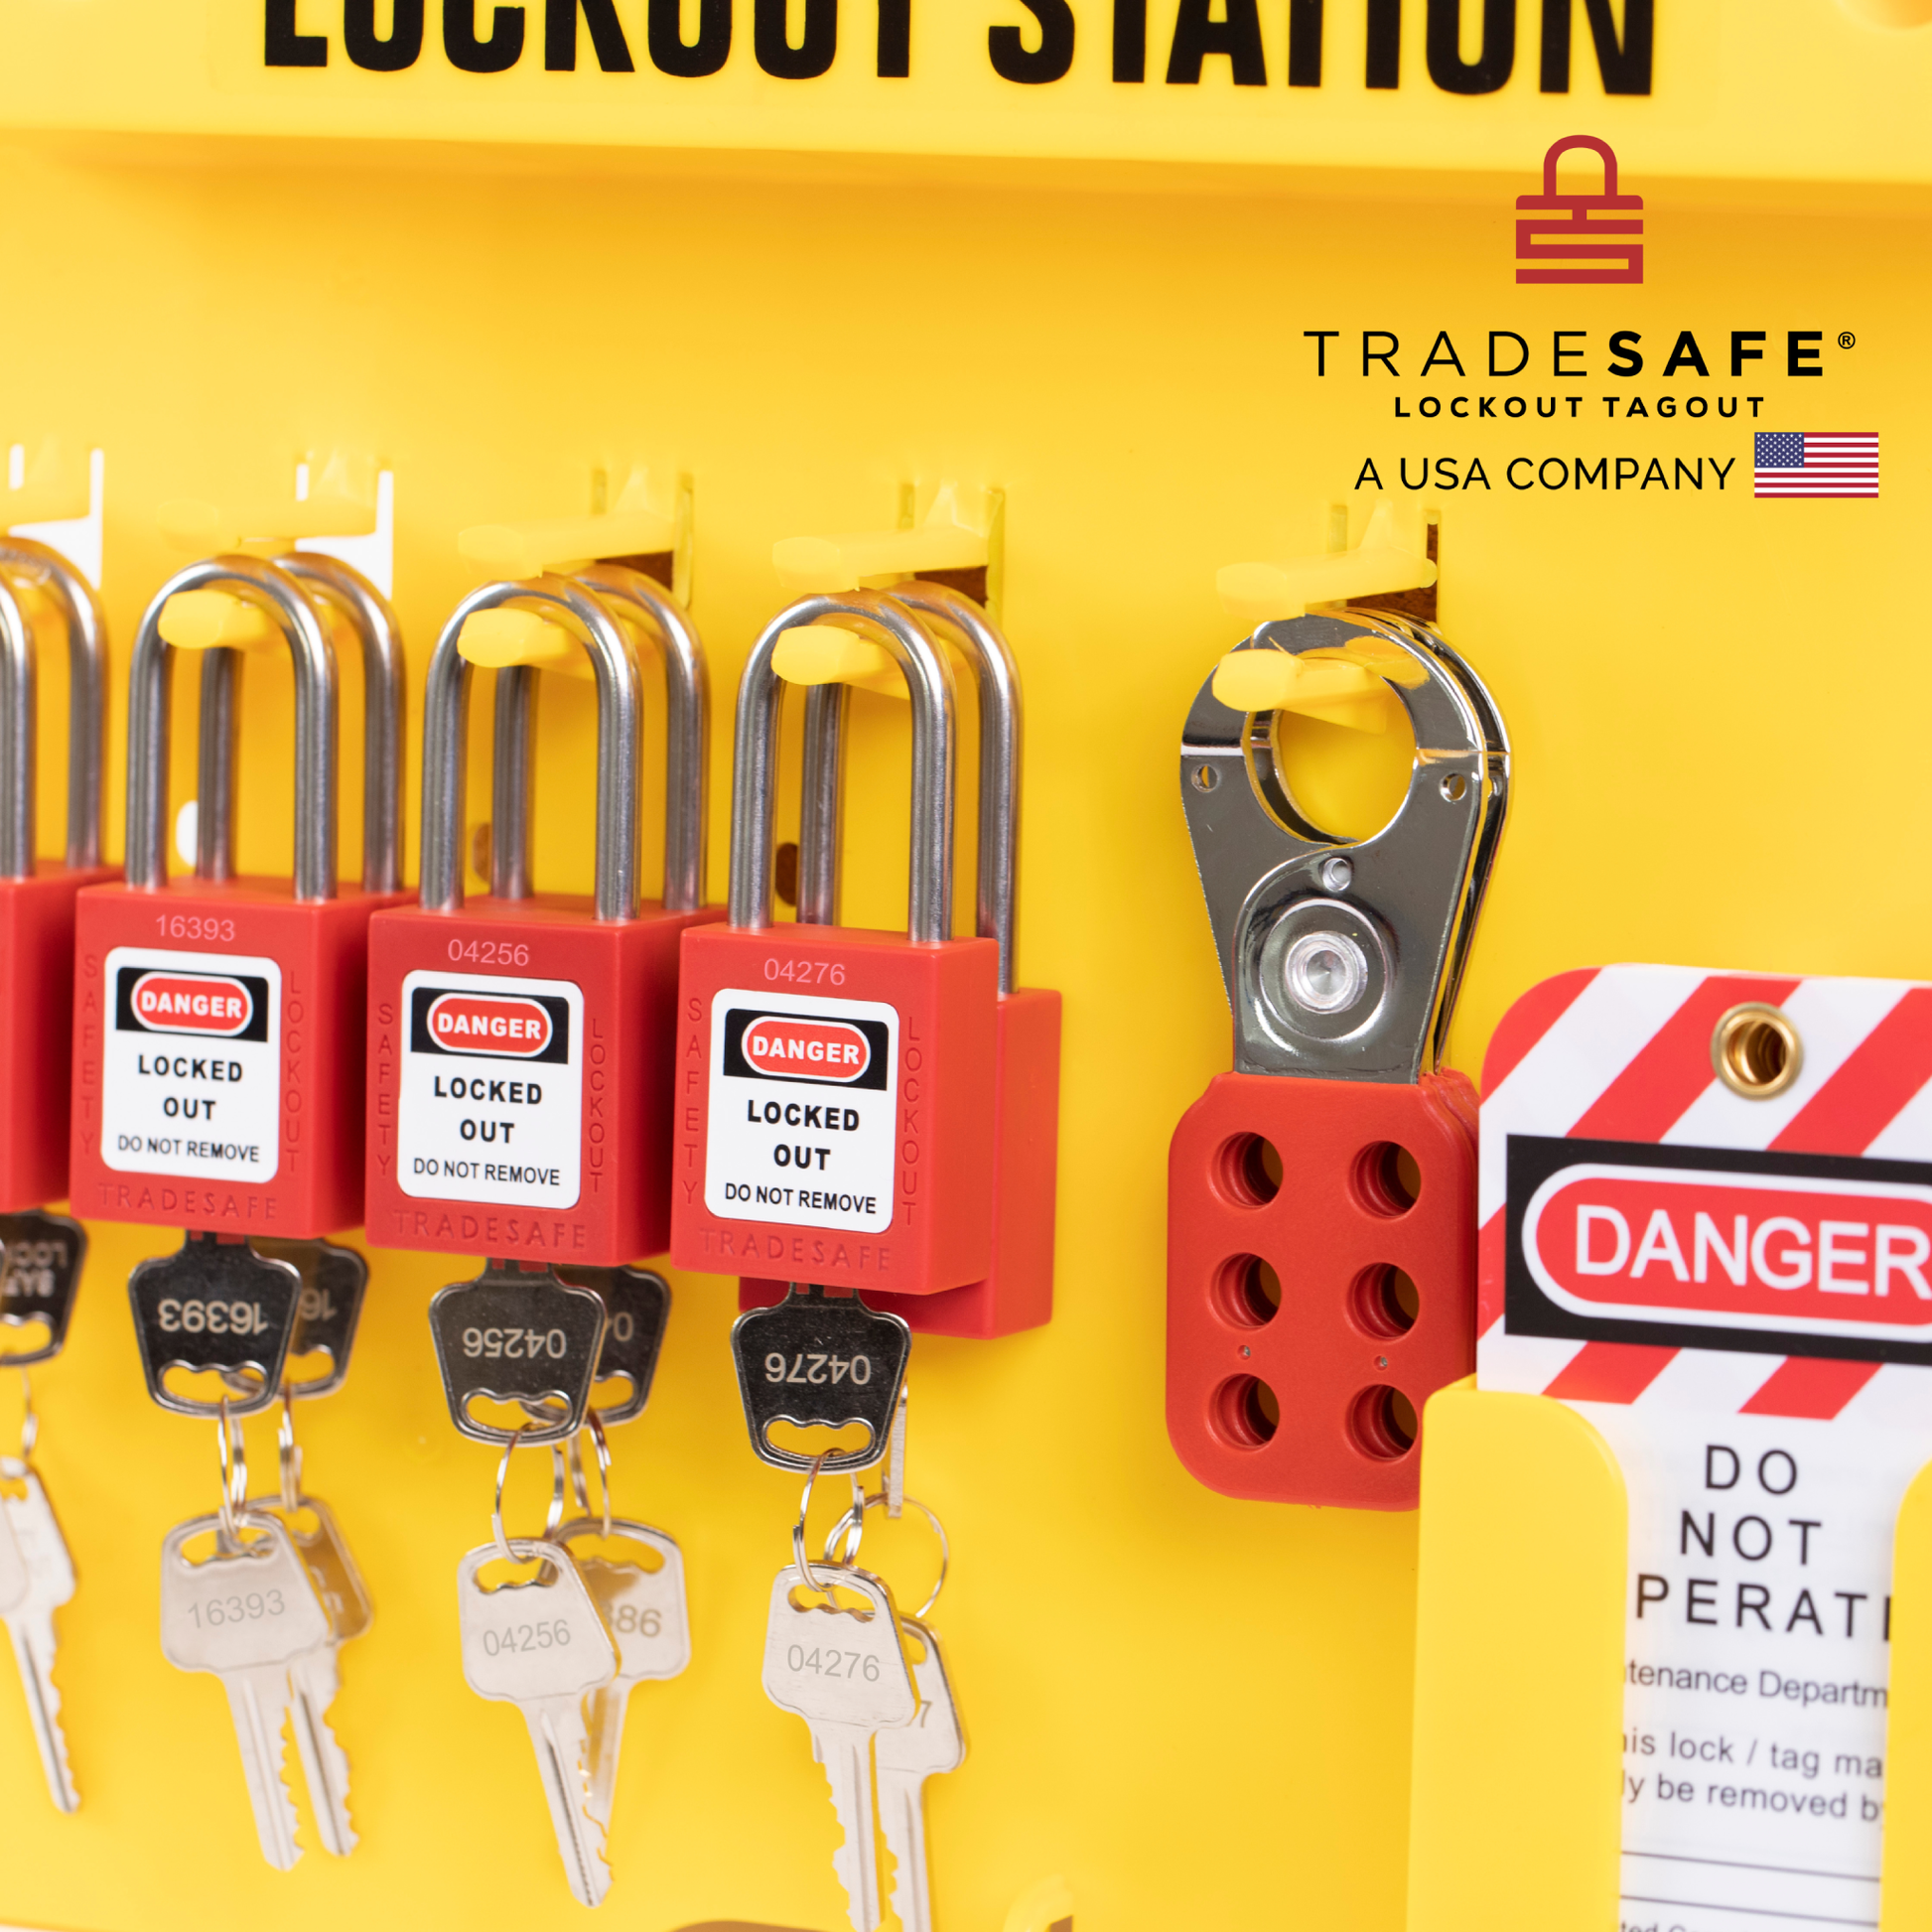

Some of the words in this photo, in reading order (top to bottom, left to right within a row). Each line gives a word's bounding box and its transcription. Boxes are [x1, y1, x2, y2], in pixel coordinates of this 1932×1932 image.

[155, 914, 236, 941] 16393
[448, 938, 530, 967] 04256
[763, 957, 847, 987] 04276
[141, 990, 243, 1020] DANGER
[438, 1013, 542, 1040] DANGER
[80, 954, 99, 1156] SAFETY
[137, 1053, 243, 1083] LOCKED
[752, 1035, 861, 1065] DANGER
[284, 970, 304, 1173] LOCKOUT
[377, 1003, 394, 1176] SAFETY
[434, 1075, 543, 1106] LOCKED
[163, 1097, 216, 1121] OUT
[589, 1018, 607, 1193] LOCKOUT
[682, 997, 703, 1206] SAFETY
[747, 1099, 861, 1132] LOCKED
[460, 1118, 515, 1144] OUT
[901, 1016, 922, 1226] LOCKOUT
[118, 1135, 143, 1152] DO
[147, 1138, 183, 1156] NOT
[187, 1142, 260, 1164] REMOVE
[773, 1143, 832, 1171] OUT
[414, 1158, 439, 1175] DO
[444, 1160, 481, 1180] NOT
[484, 1164, 561, 1186] REMOVE
[97, 1182, 278, 1221] TRADESAFE
[725, 1182, 752, 1201] DO
[756, 1185, 793, 1206] NOT
[798, 1189, 877, 1214] REMOVE
[394, 1209, 586, 1250] TRADESAFE
[700, 1227, 891, 1272] TRADESAFE
[1576, 1204, 1932, 1301] DANGER
[157, 1299, 269, 1335] 16393
[463, 1326, 567, 1359] 04256
[764, 1351, 872, 1386] 04276
[1705, 1444, 1798, 1495] DO
[1680, 1509, 1822, 1567] NOT
[187, 1587, 286, 1628] 16393
[1636, 1573, 1891, 1642] PERAT
[483, 1619, 572, 1657] 04256
[786, 1644, 882, 1682] 04276
[1625, 1659, 1748, 1696] tenance
[1759, 1669, 1888, 1709] Departm
[1670, 1730, 1734, 1764] lock
[1770, 1741, 1820, 1779] tag
[1835, 1752, 1884, 1780] ma
[1657, 1773, 1695, 1803] be
[1708, 1783, 1848, 1819] removed
